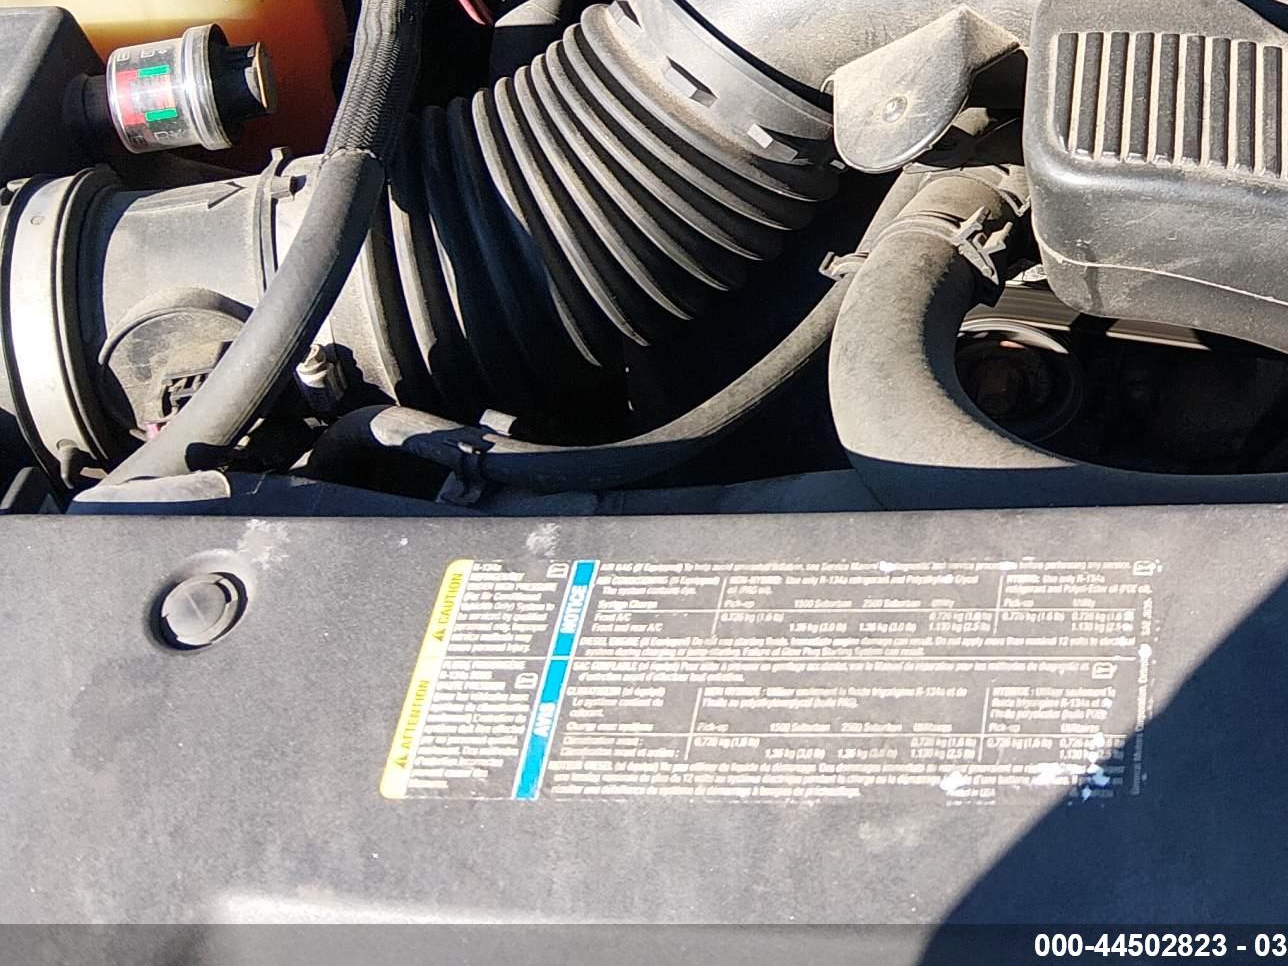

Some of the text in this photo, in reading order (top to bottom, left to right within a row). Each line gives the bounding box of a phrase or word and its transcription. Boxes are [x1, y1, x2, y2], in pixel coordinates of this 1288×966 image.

[438, 573, 463, 628] CAUTION
[559, 585, 588, 634] NOTICE
[401, 680, 430, 749] ATTENTION
